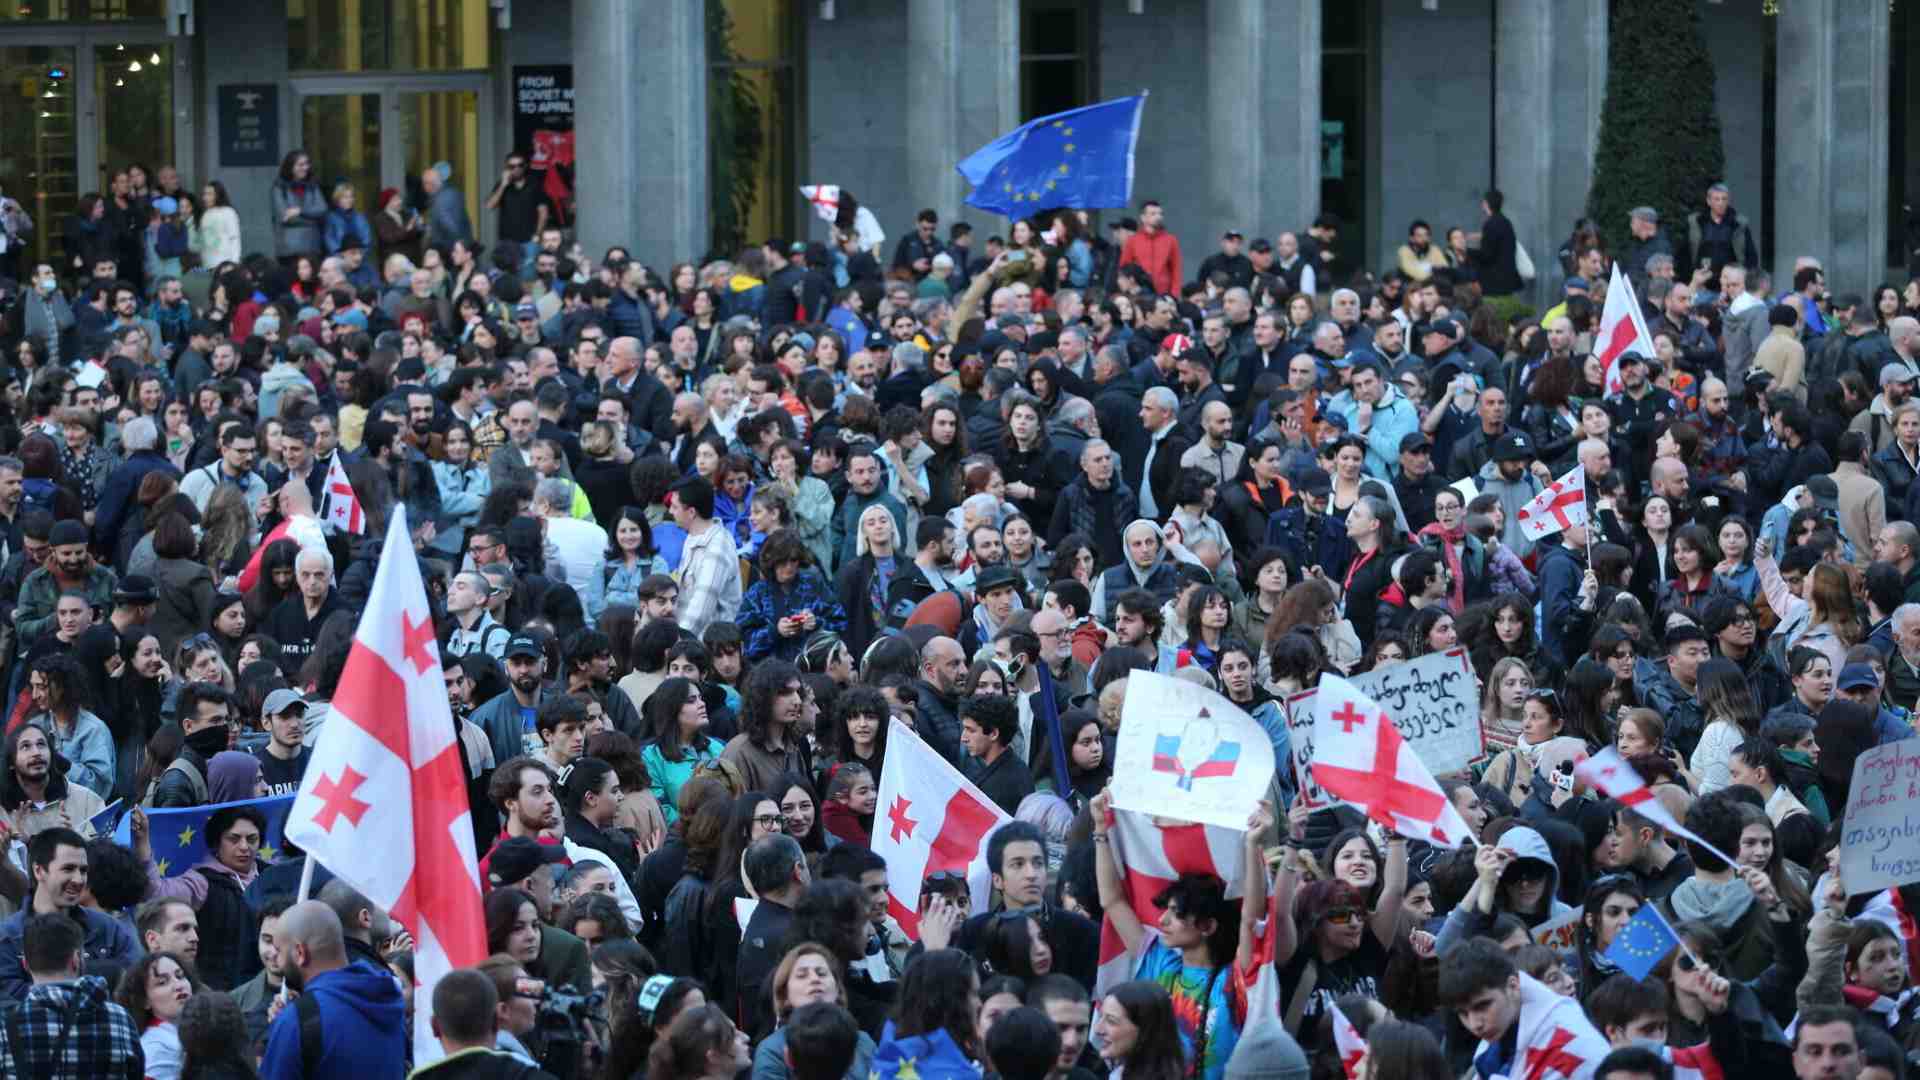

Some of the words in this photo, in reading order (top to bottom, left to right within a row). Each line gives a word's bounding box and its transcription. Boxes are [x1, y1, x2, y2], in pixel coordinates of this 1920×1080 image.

[519, 76, 555, 89] FROM
[519, 89, 561, 101] SOVIET
[519, 102, 536, 113] TO
[538, 101, 574, 113] APRIL
